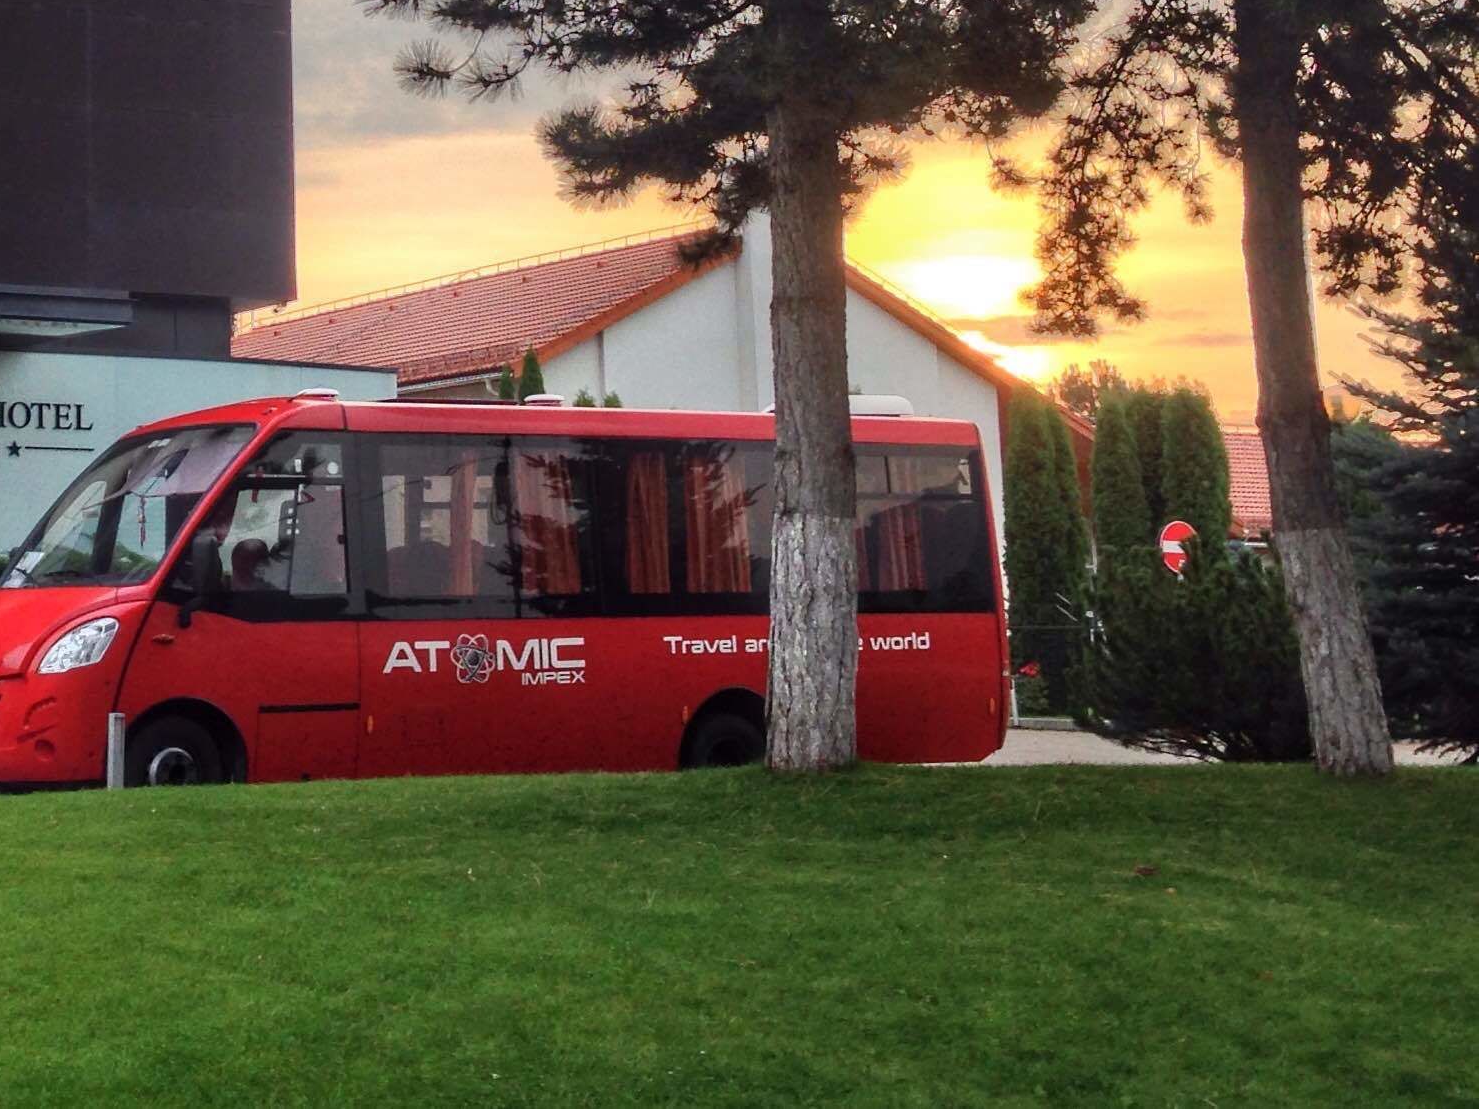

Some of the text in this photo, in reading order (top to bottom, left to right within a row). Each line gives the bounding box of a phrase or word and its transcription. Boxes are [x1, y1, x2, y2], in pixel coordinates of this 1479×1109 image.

[663, 635, 737, 654] Travel
[871, 632, 930, 651] world
[521, 670, 585, 686] IMPEX
